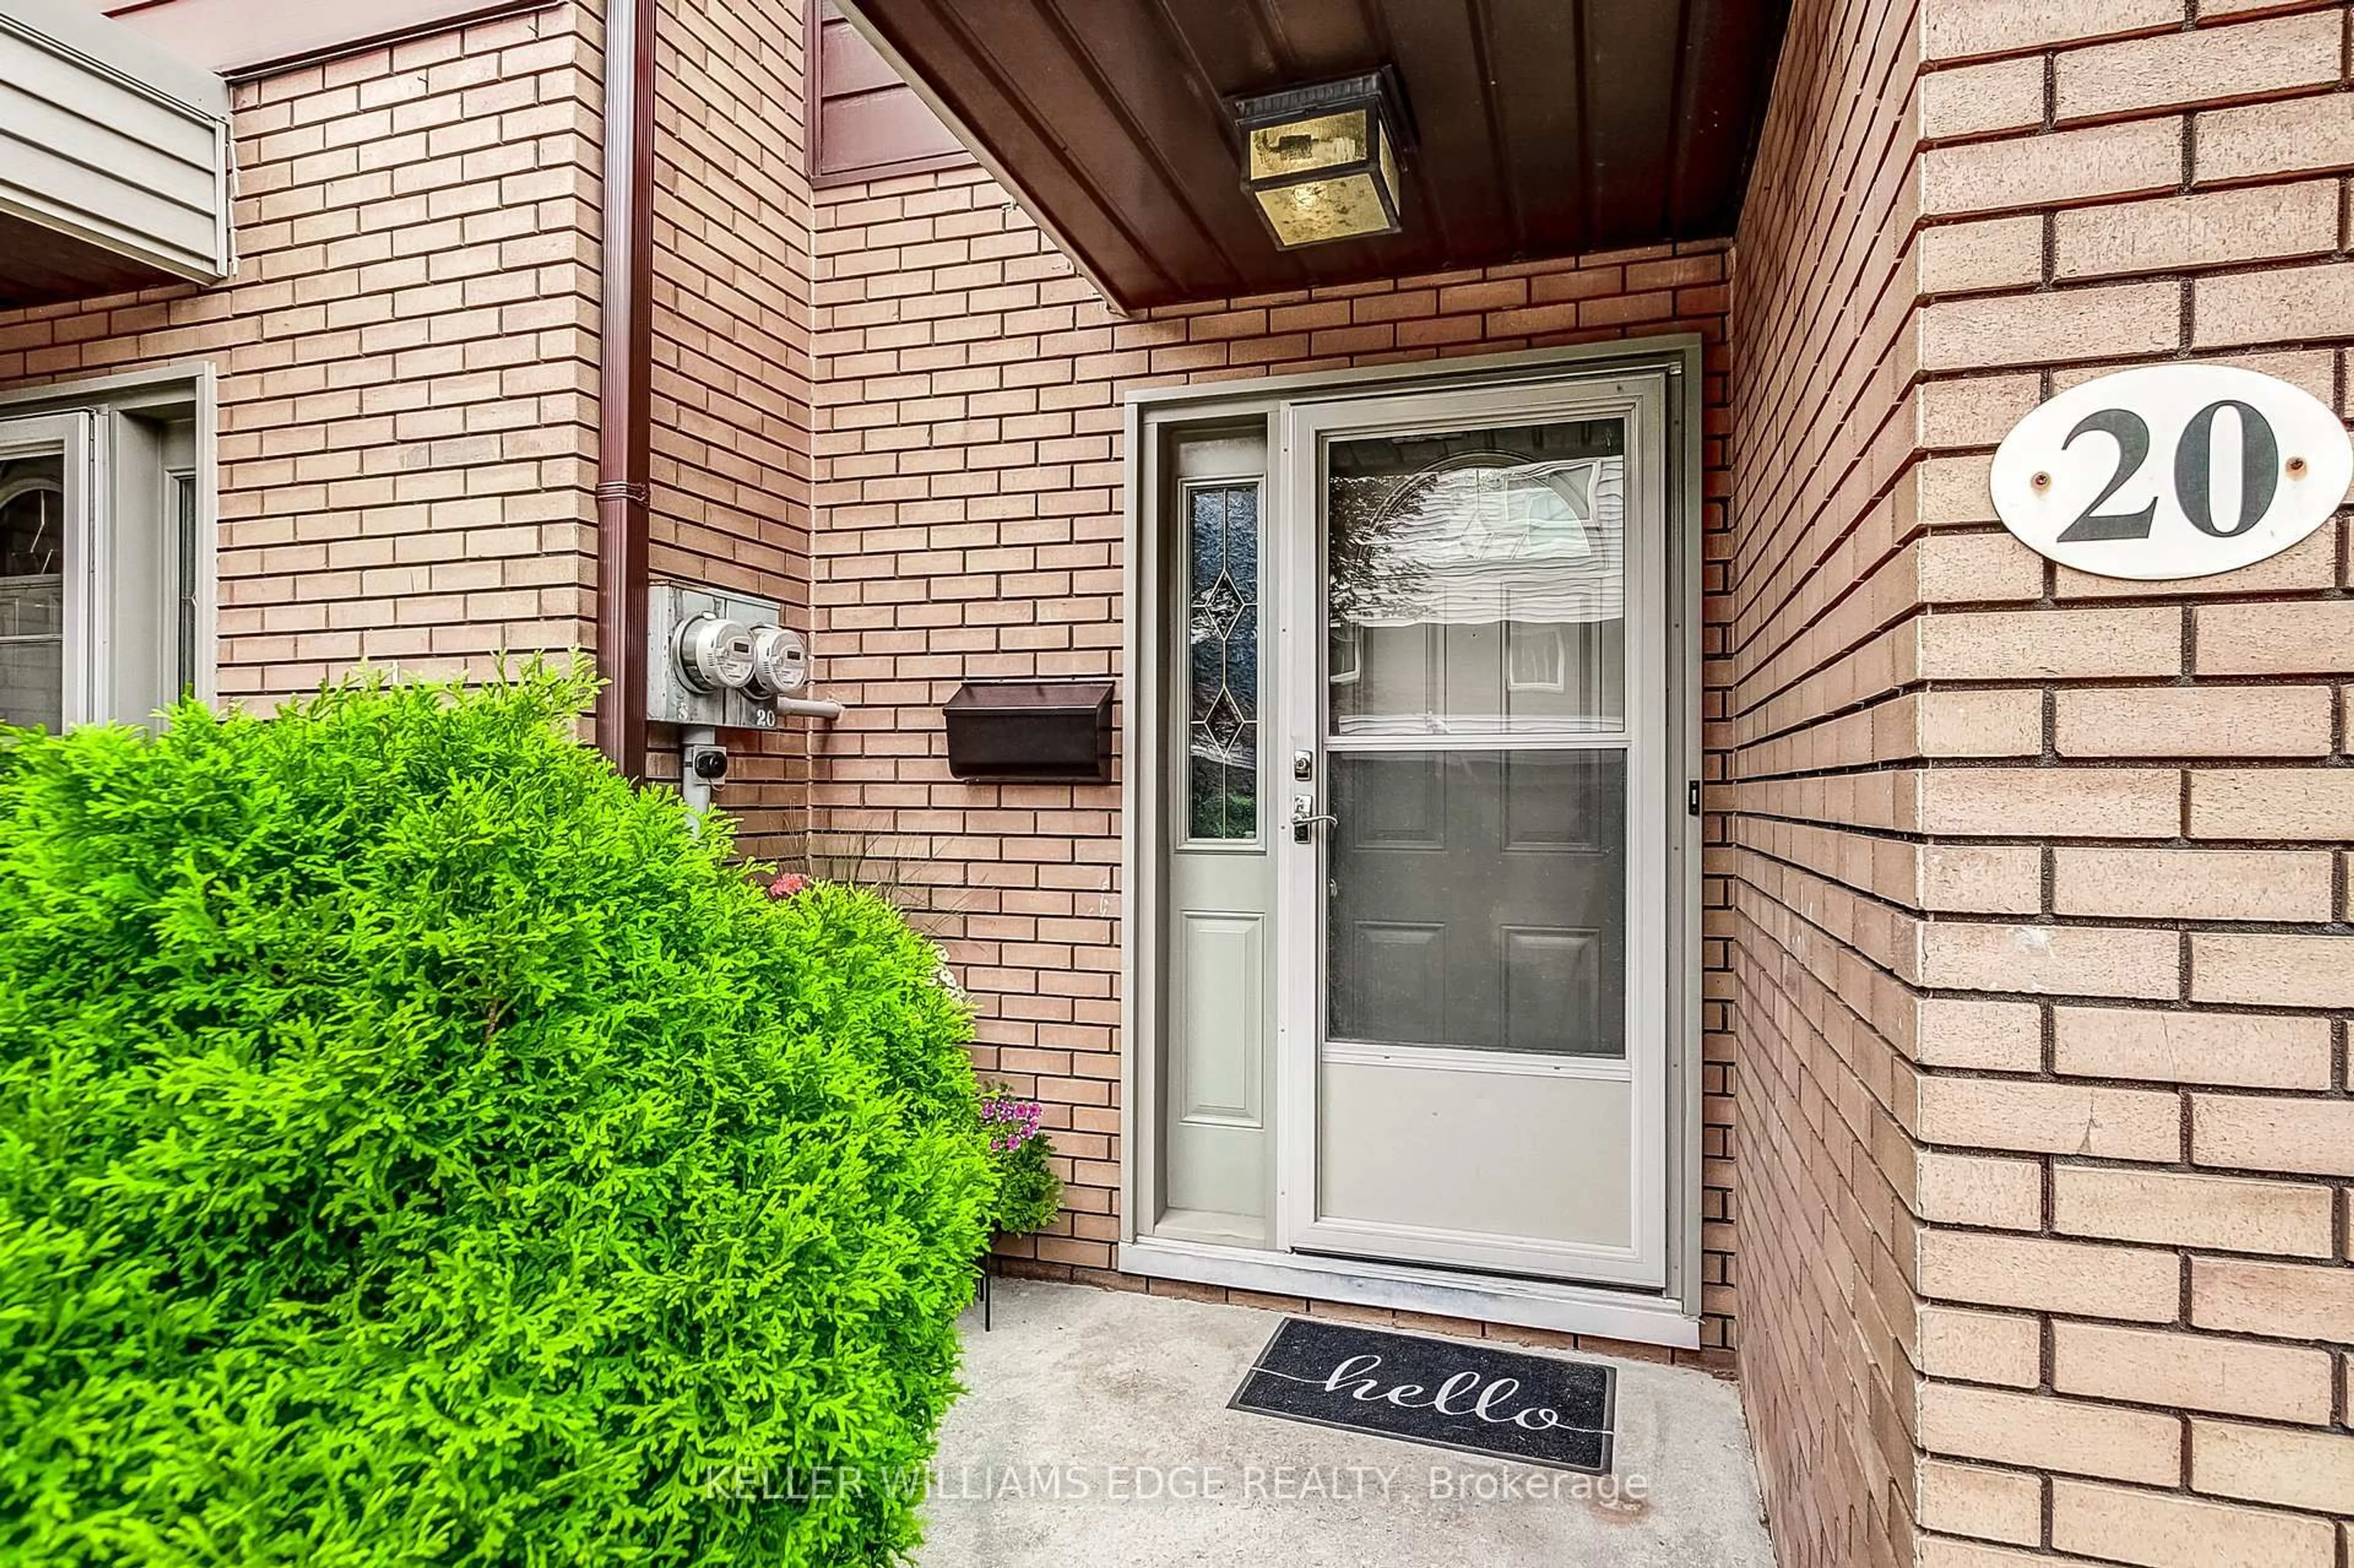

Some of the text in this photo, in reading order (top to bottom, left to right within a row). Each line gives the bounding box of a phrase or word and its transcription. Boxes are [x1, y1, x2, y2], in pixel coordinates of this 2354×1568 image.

[2057, 399, 2279, 543] 20
[756, 709, 775, 727] 20
[1324, 1354, 1560, 1431] hello
